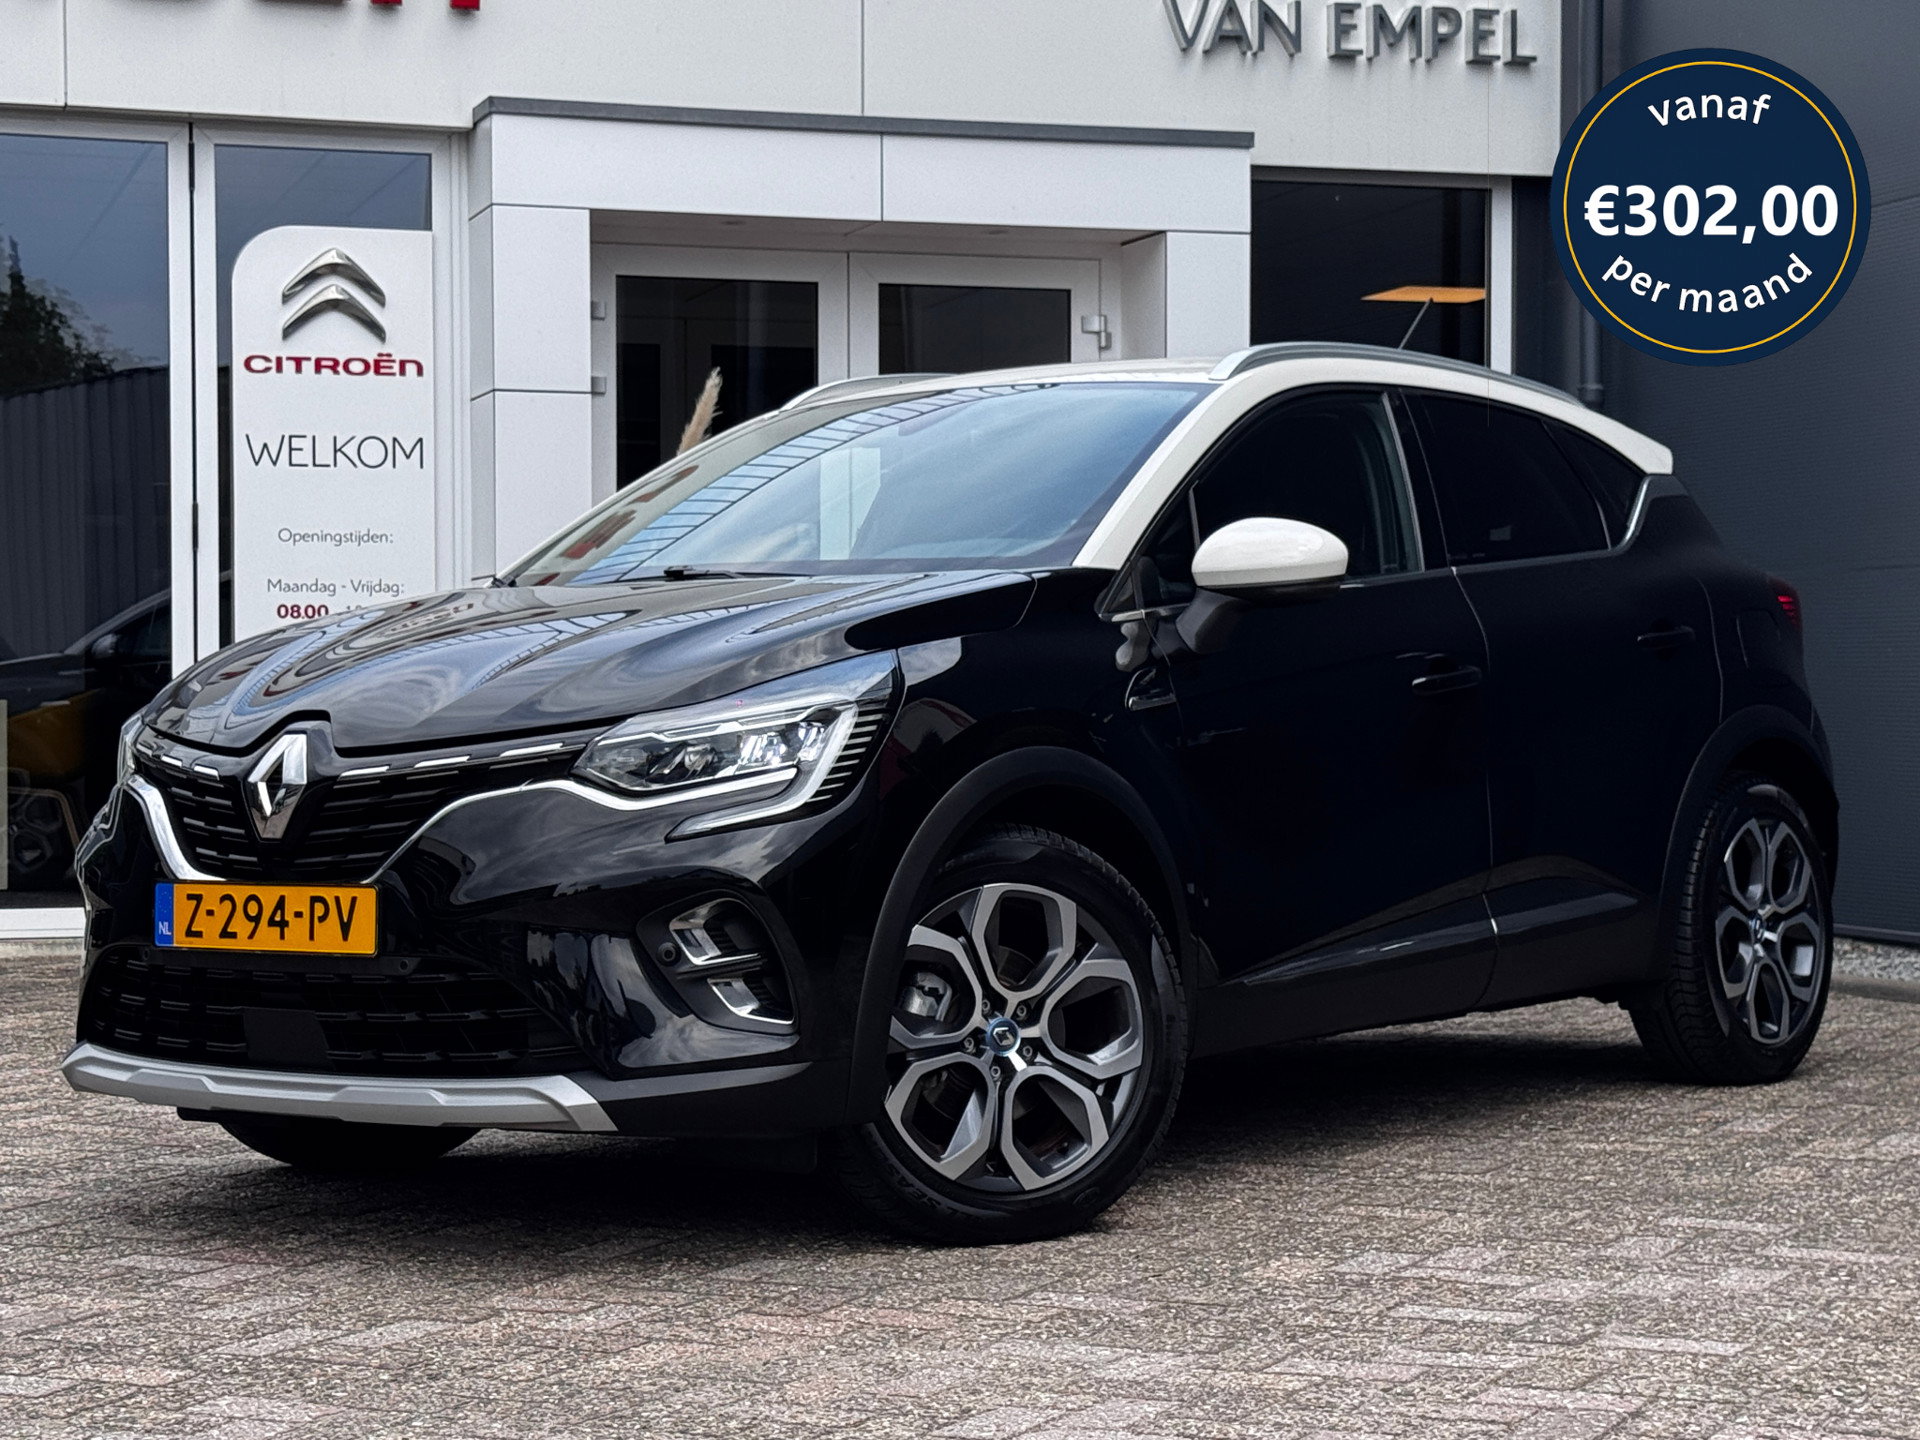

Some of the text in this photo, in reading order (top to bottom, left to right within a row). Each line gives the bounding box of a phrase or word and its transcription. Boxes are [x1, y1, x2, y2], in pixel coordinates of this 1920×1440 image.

[1162, 0, 1538, 66] VAN EMPEL
[246, 434, 425, 469] WELKOM
[277, 527, 394, 547] Openingstijden:
[267, 578, 337, 597] Maandag
[350, 578, 405, 597] Vrijdag:
[277, 604, 330, 619] 08.00
[184, 893, 358, 942] Z-294-PV
[158, 921, 172, 936] NL
